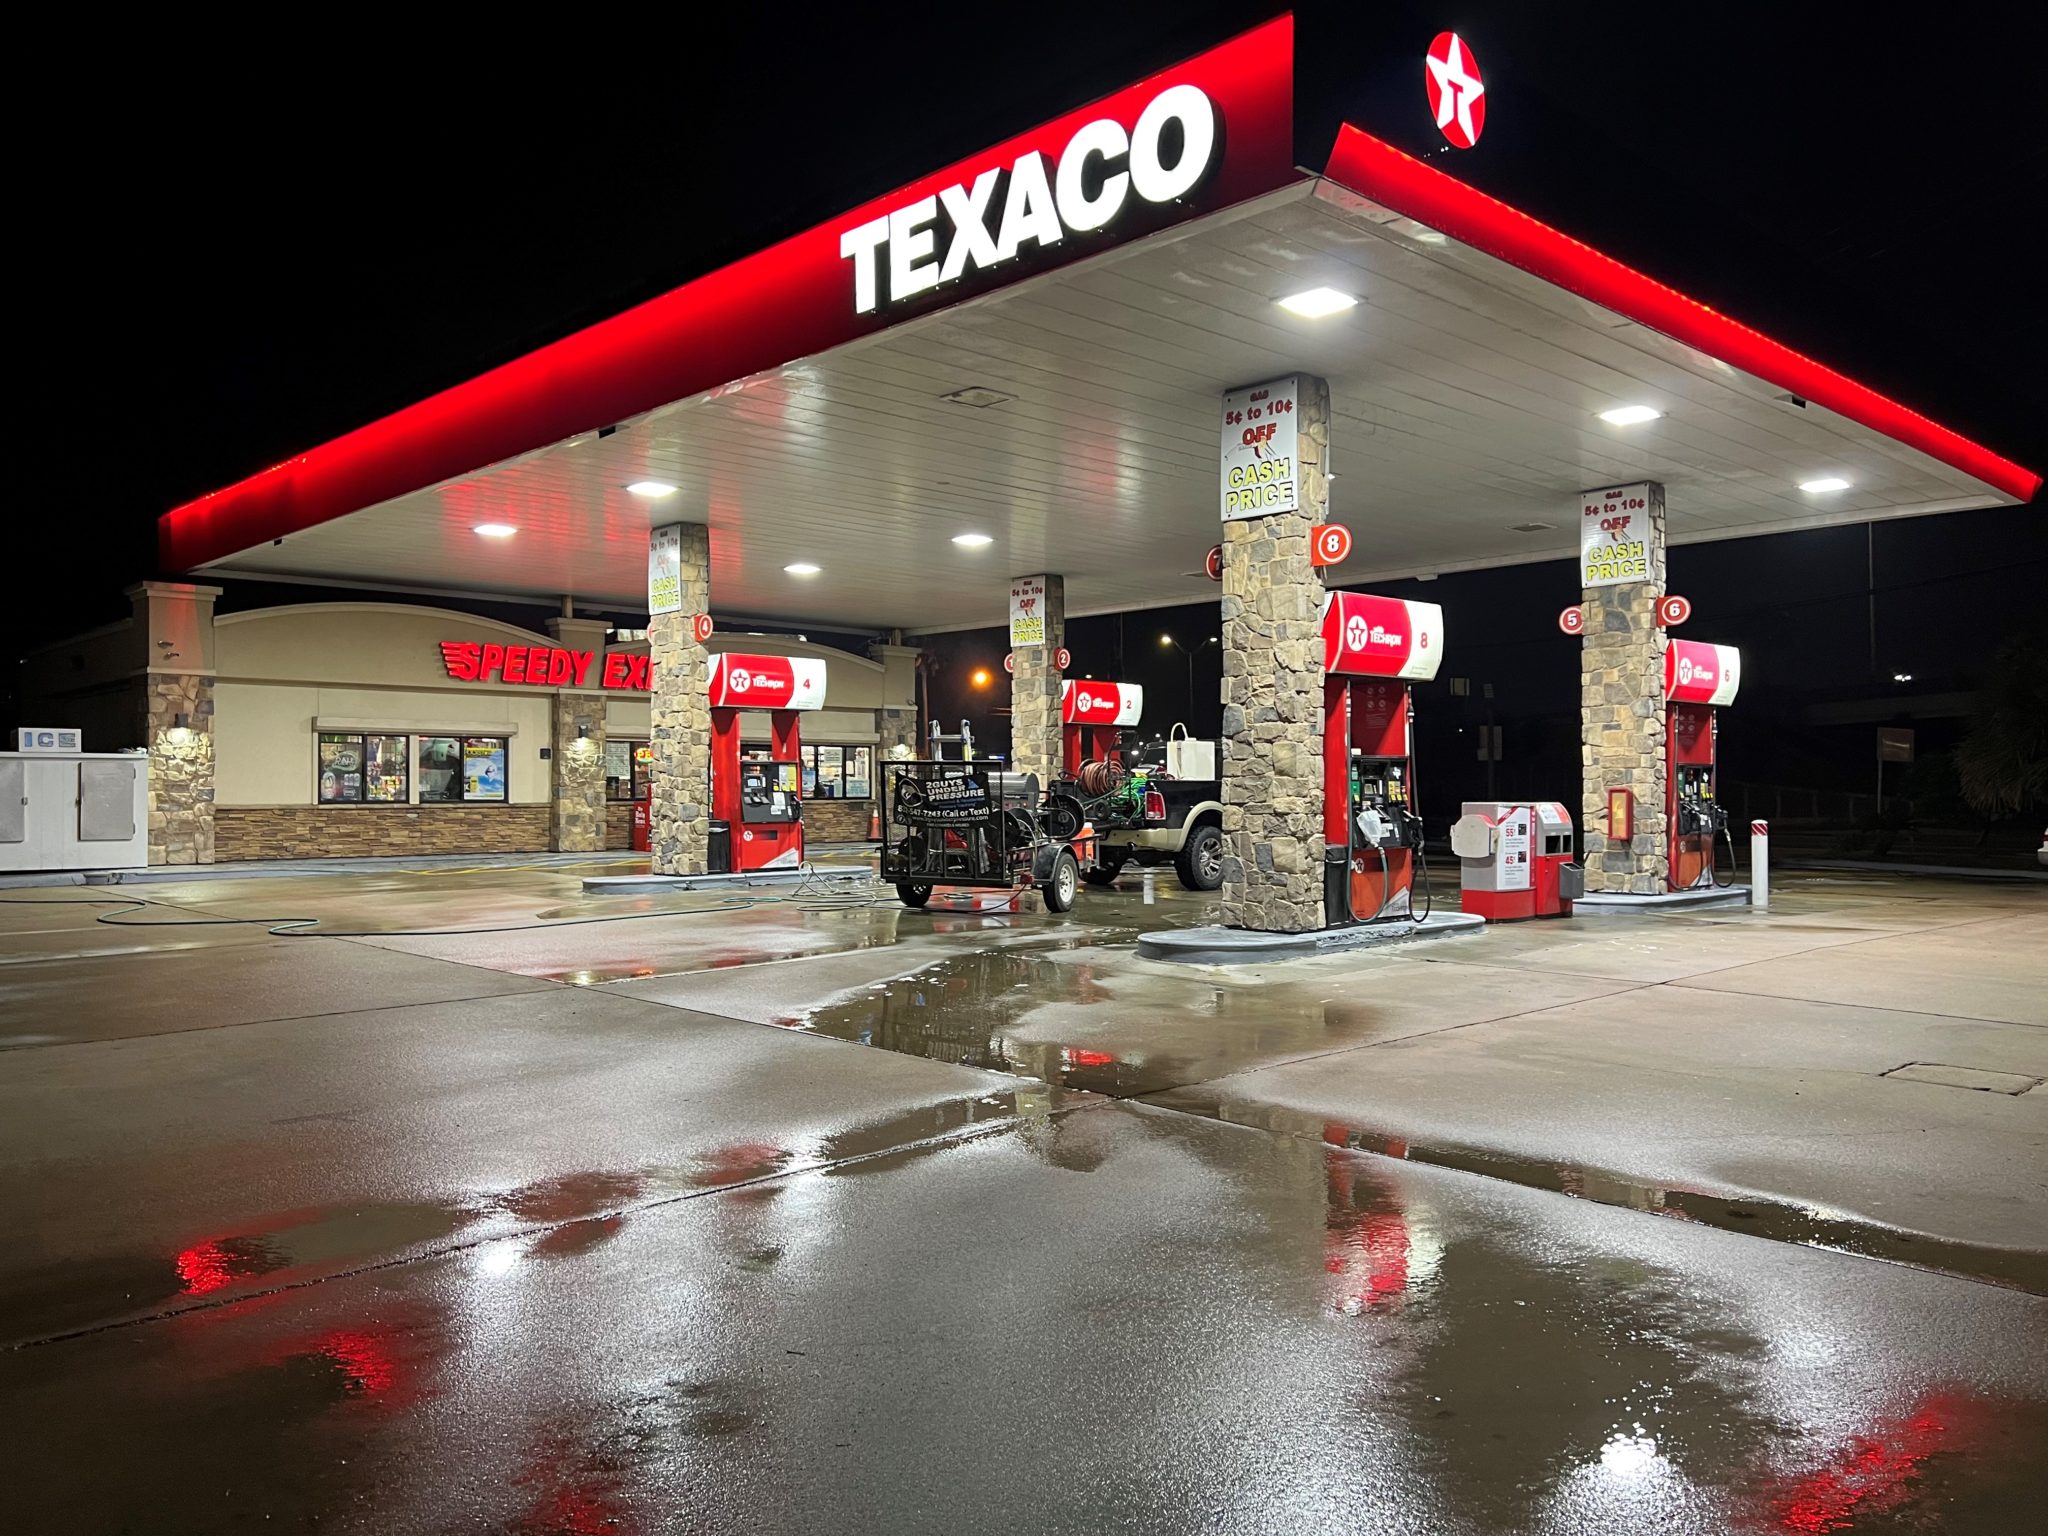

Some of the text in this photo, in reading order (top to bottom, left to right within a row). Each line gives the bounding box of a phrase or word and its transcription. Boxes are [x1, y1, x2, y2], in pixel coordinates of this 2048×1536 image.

[840, 84, 1216, 314] TEXACO
[1225, 398, 1293, 426] 5¢ to 10¢
[1242, 422, 1277, 446] OFF
[1228, 457, 1291, 489] CASH
[1226, 481, 1294, 513] PRICE
[1584, 498, 1645, 516] 5¢ to 10¢
[1600, 515, 1631, 532] OFF
[1326, 534, 1340, 553] 8
[1588, 541, 1644, 563] CASH
[1586, 559, 1647, 581] PRICE
[652, 575, 678, 593] CASH
[651, 590, 680, 608] PRICE
[1019, 598, 1036, 609] OFF
[1669, 603, 1681, 617] 6
[701, 621, 709, 632] 4
[1013, 617, 1042, 630] CASH
[1567, 613, 1577, 626] 5
[1012, 630, 1044, 642] PRICE
[1420, 632, 1428, 649] 8
[440, 640, 595, 687] SPEEDY
[1060, 653, 1067, 664] 2
[1724, 669, 1731, 682] 6
[803, 679, 811, 690] 4
[1126, 700, 1132, 709] 2
[24, 731, 76, 748] ICE
[925, 778, 964, 789] 2GUYS
[927, 785, 966, 795] UNDER
[928, 788, 985, 802] PRESSURE
[941, 809, 959, 818] (Call
[969, 806, 990, 816] Text)
